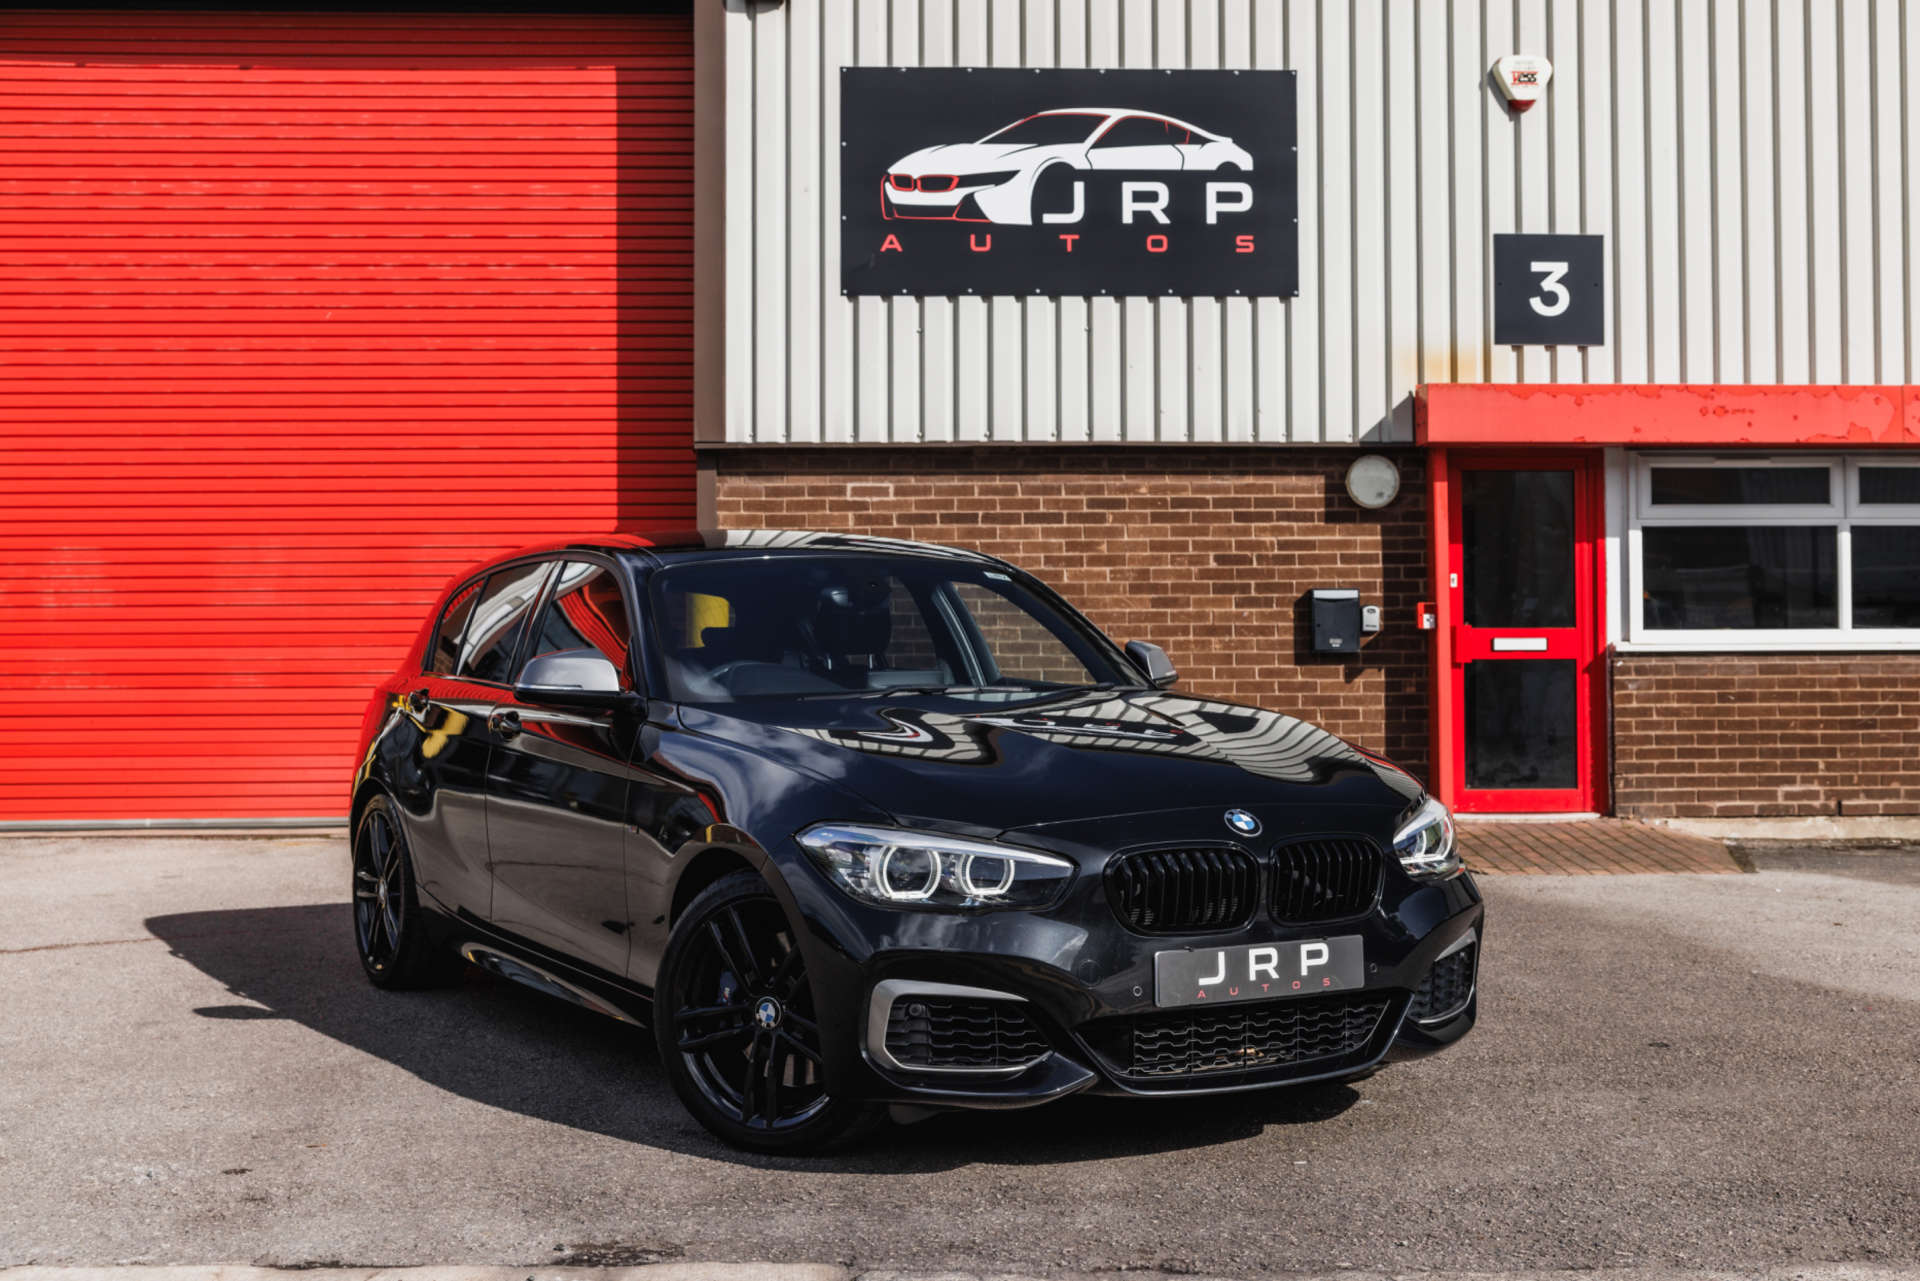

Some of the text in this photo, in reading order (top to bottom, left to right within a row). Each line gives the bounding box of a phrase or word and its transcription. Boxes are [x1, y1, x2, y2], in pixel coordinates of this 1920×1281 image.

[1042, 182, 1254, 224] JRP
[880, 234, 1255, 253] AUTOS
[1529, 261, 1570, 317] 3
[1198, 942, 1329, 986] JRP
[1197, 977, 1331, 999] AUTOS
